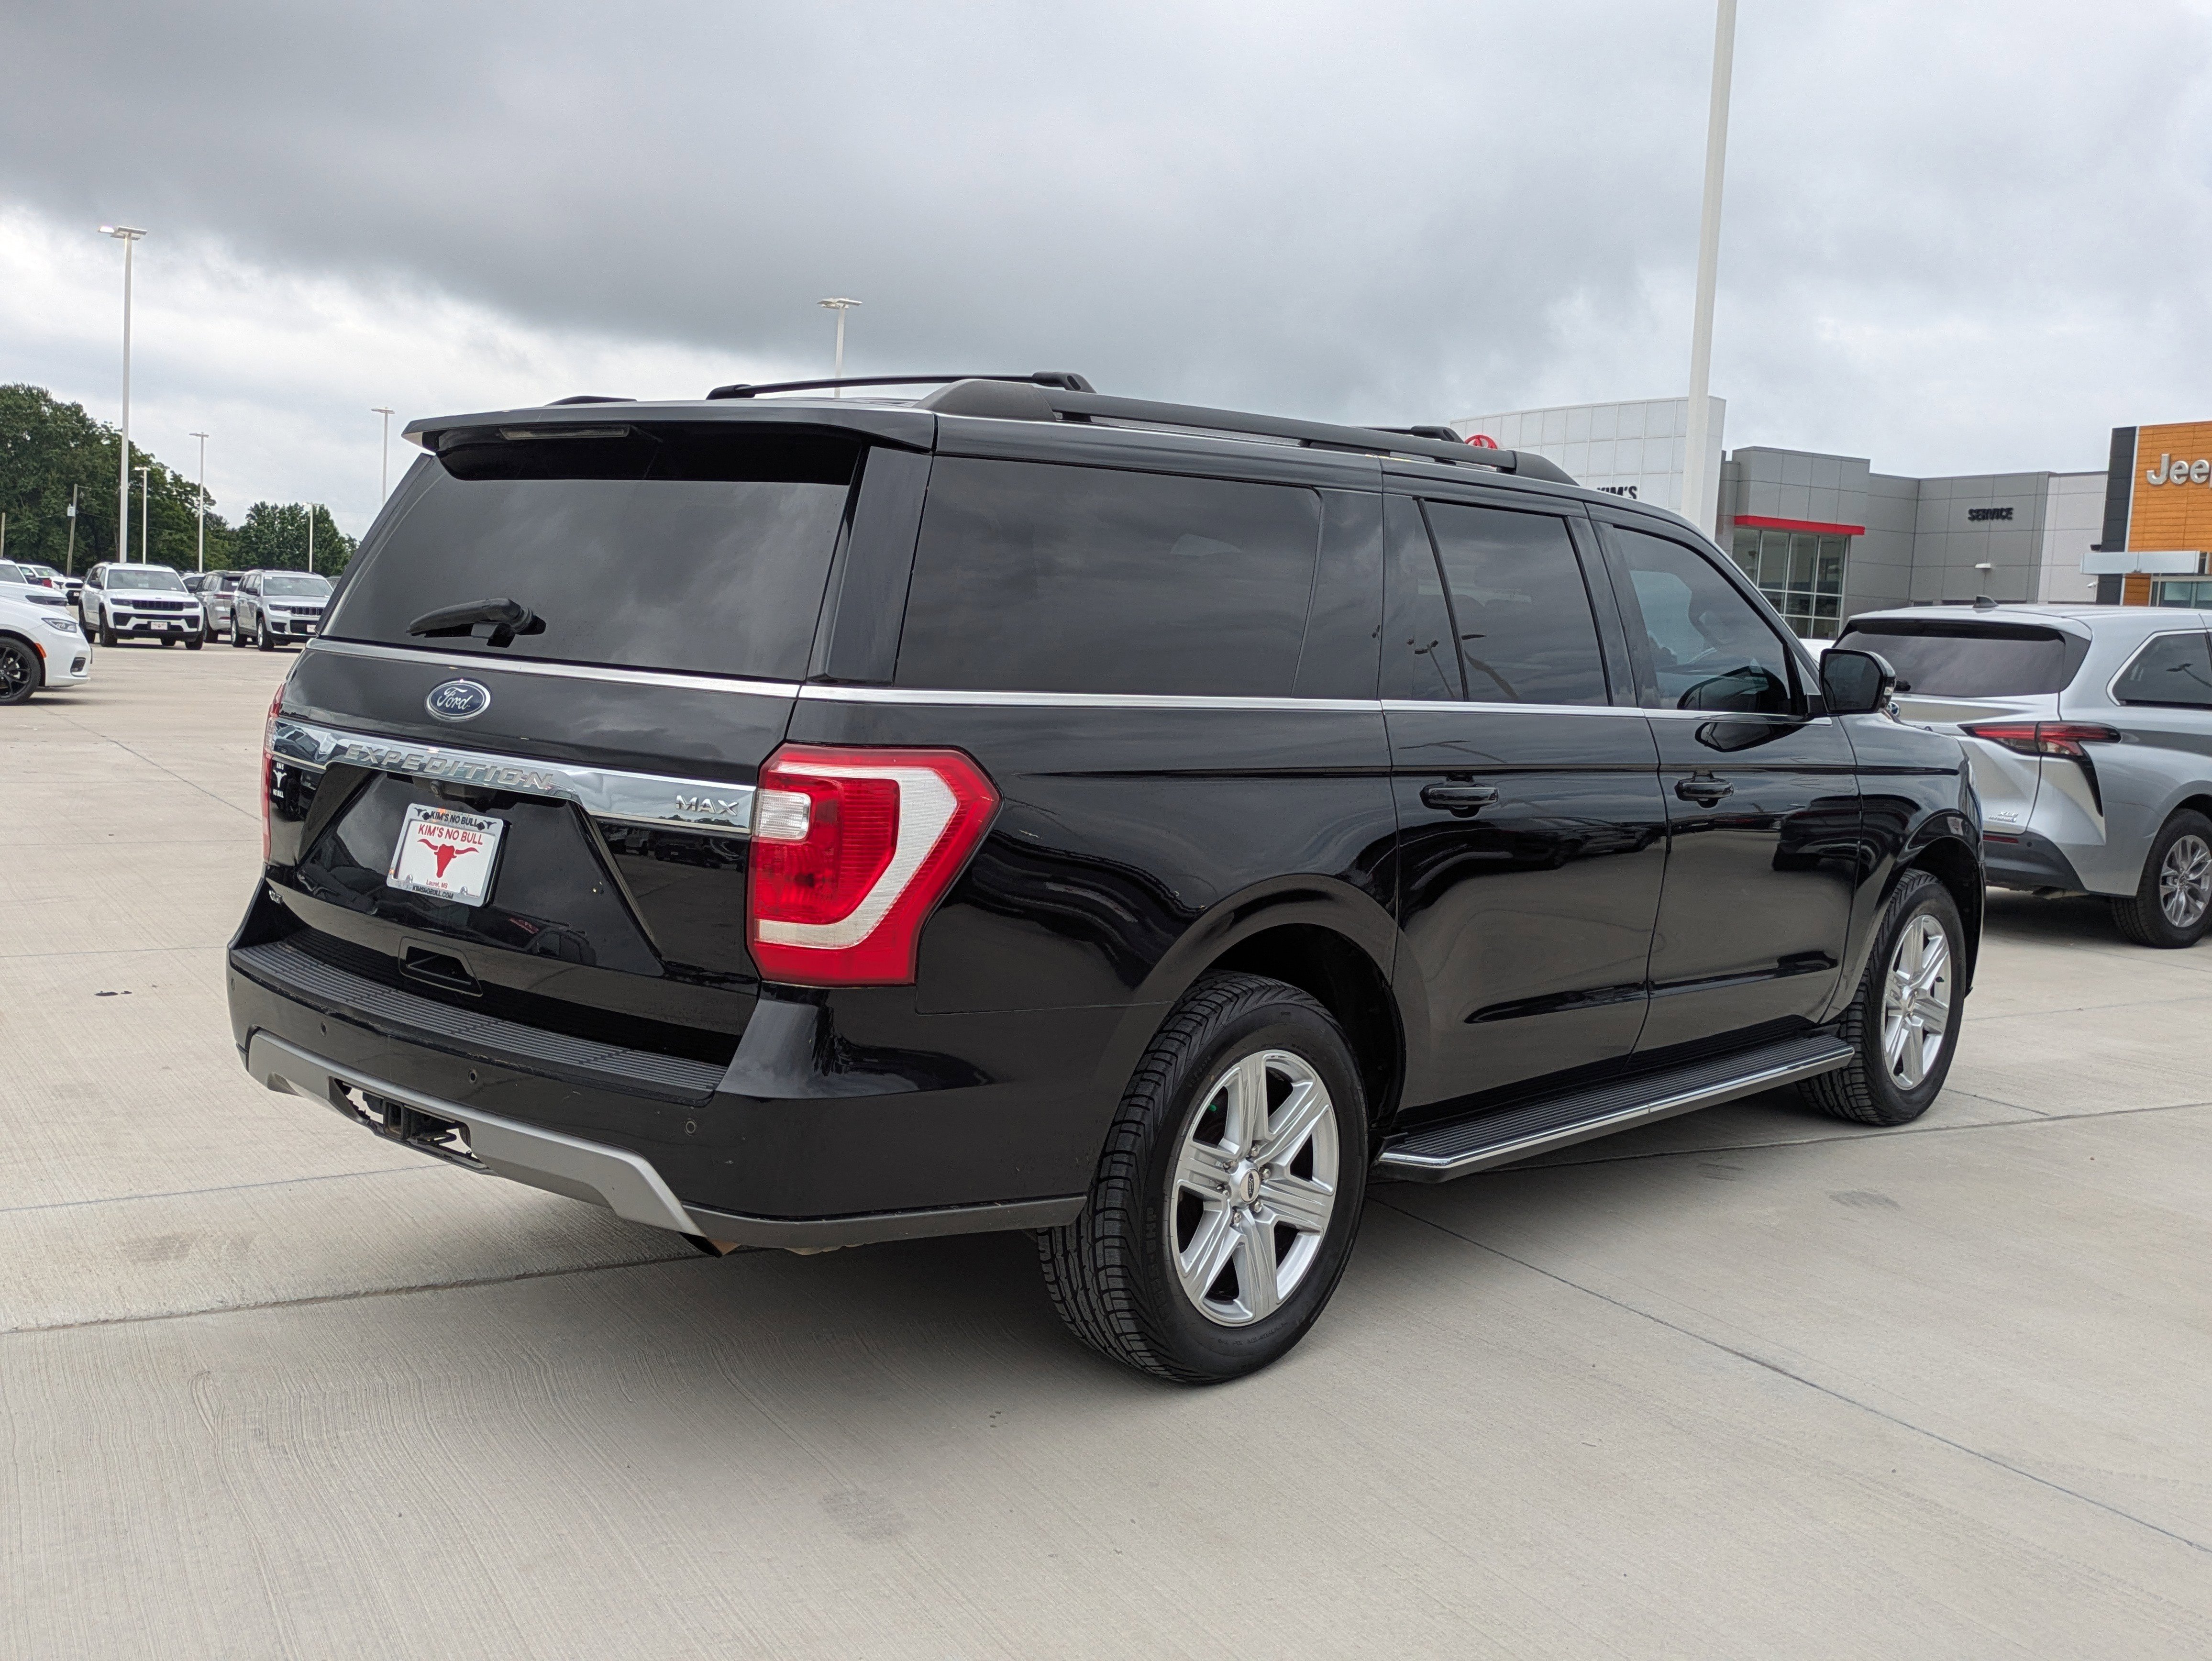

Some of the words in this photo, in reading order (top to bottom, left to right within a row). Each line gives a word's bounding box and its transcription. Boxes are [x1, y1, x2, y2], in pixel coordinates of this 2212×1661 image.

[2146, 454, 2212, 488] Jee
[1967, 508, 2013, 521] SERVICE
[437, 687, 473, 710] Ford
[343, 743, 553, 789] EXPEDITION
[675, 795, 739, 816] MAX
[431, 810, 449, 821] KIM'S
[450, 814, 460, 824] NO
[461, 816, 478, 827] BULL
[418, 824, 444, 838] KIM'S
[445, 829, 460, 841] NO
[461, 831, 483, 845] BULL
